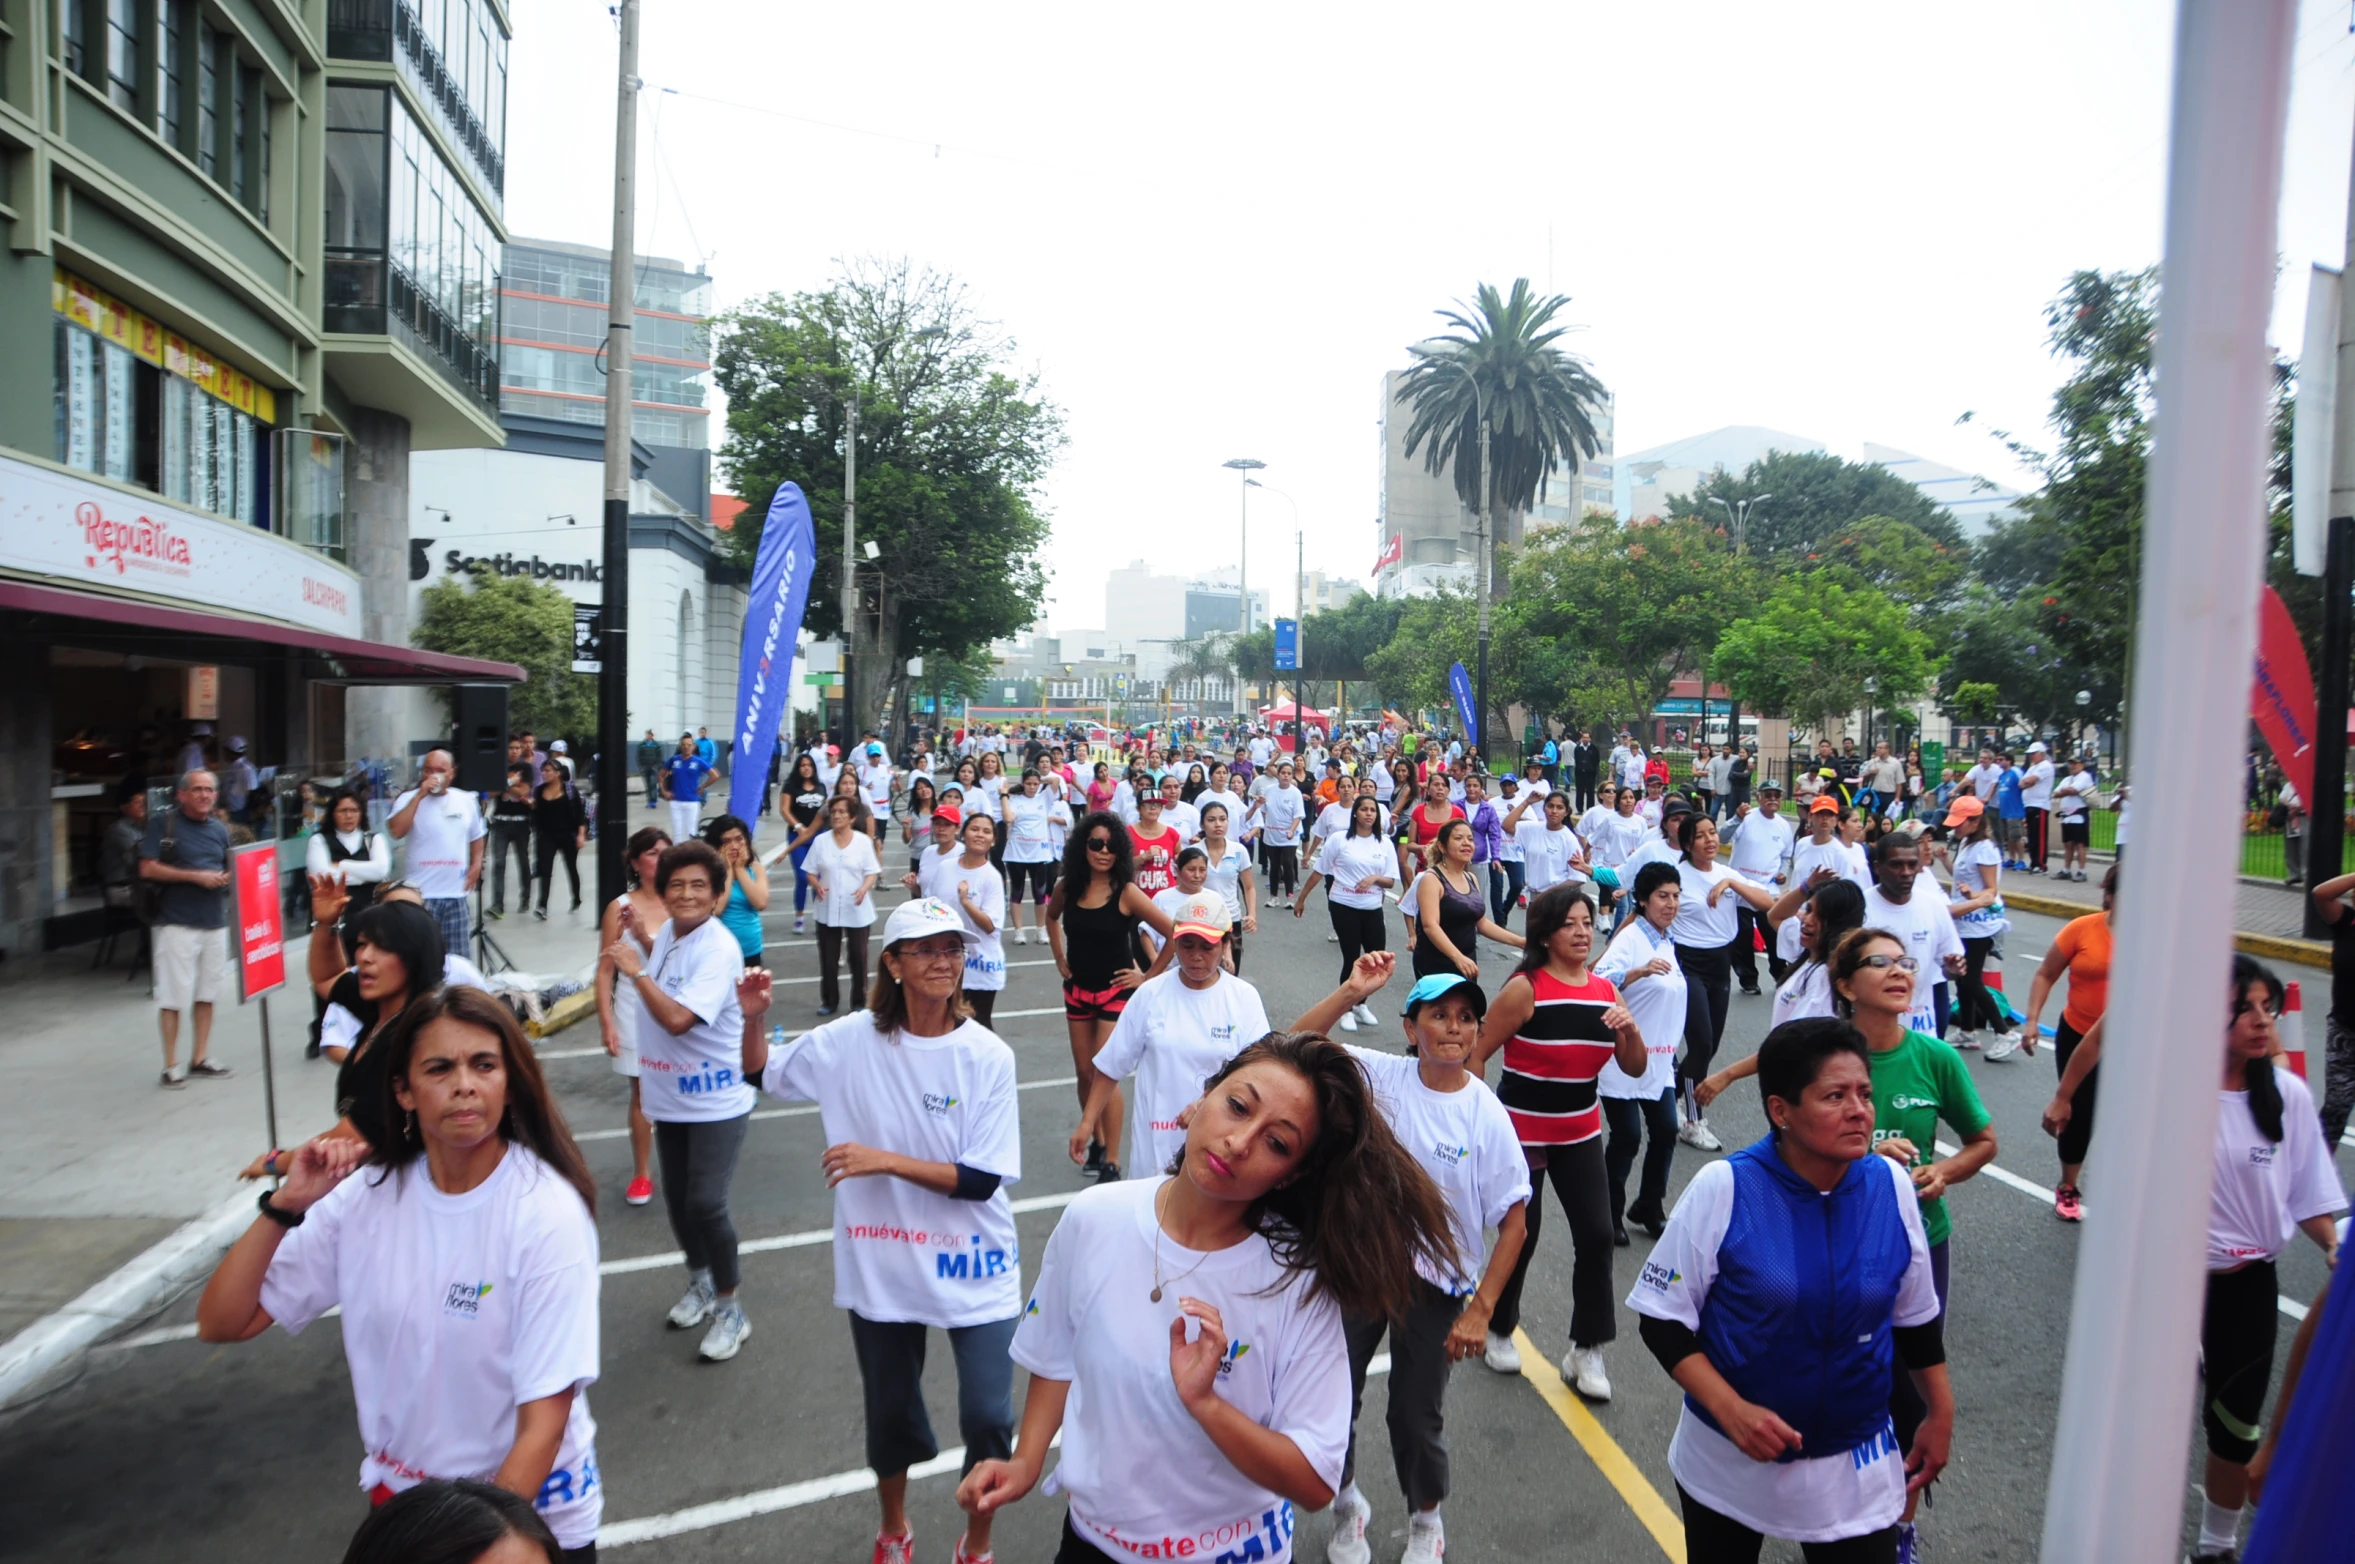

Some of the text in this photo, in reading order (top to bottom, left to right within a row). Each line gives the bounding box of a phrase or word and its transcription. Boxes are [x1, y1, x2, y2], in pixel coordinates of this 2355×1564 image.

[446, 550, 603, 582] Scotiabank
[1134, 870, 1169, 890] OURS
[923, 1093, 945, 1105] mira
[923, 1100, 947, 1116] flores
[1433, 1147, 1459, 1165] flores
[1437, 1142, 1457, 1155] mira
[930, 1234, 965, 1248] con
[449, 1283, 476, 1297] mira
[444, 1294, 478, 1313] flores
[1199, 1518, 1252, 1552] con
